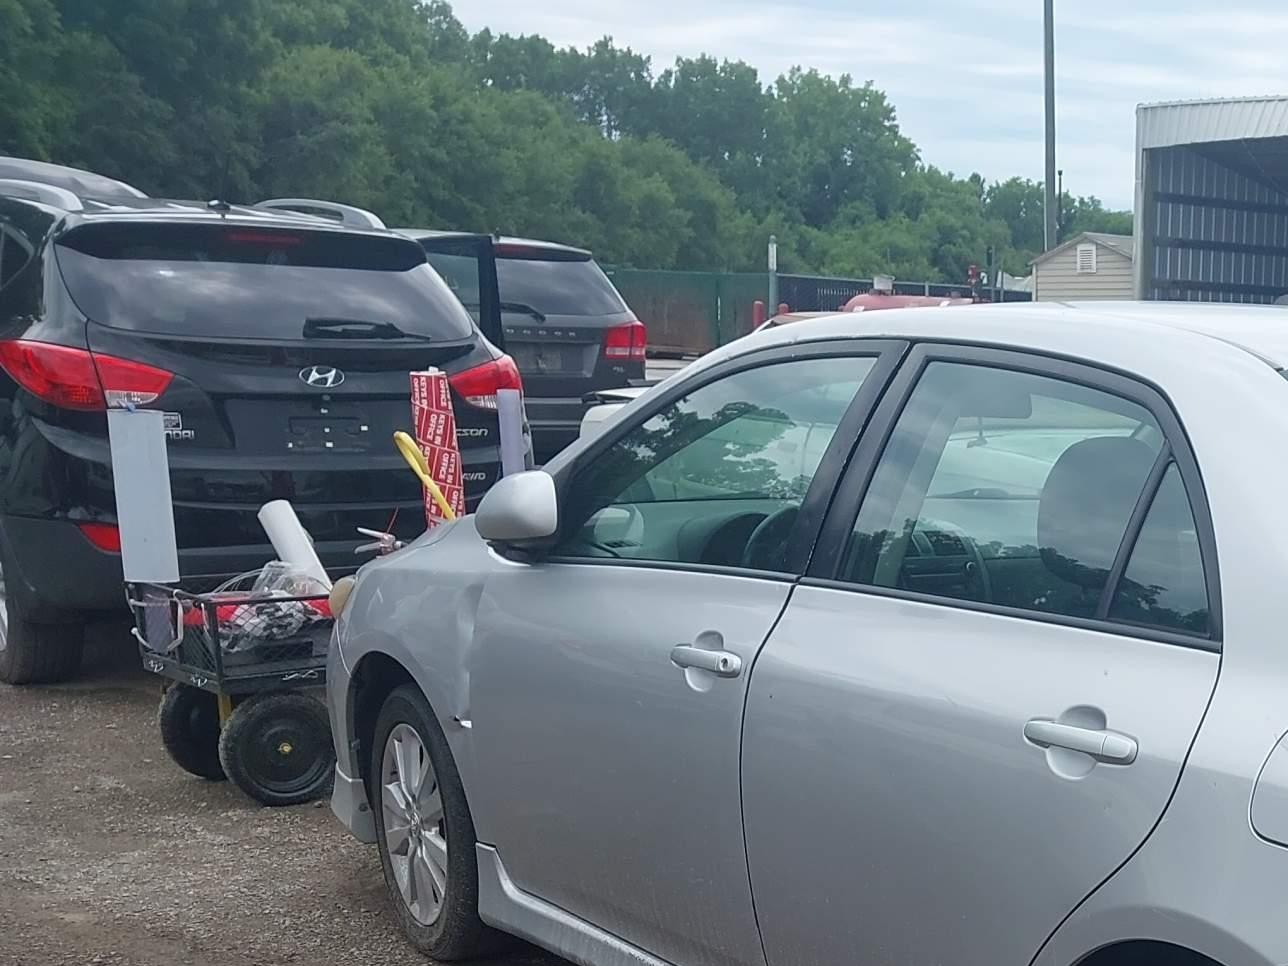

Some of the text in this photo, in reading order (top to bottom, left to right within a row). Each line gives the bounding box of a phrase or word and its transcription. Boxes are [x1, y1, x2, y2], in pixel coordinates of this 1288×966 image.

[164, 429, 195, 440] NDAI
[427, 414, 437, 441] OFFICE
[434, 414, 445, 445] KEYS IN
[439, 453, 449, 480] OFFICE
[447, 453, 456, 483] KEYS IN
